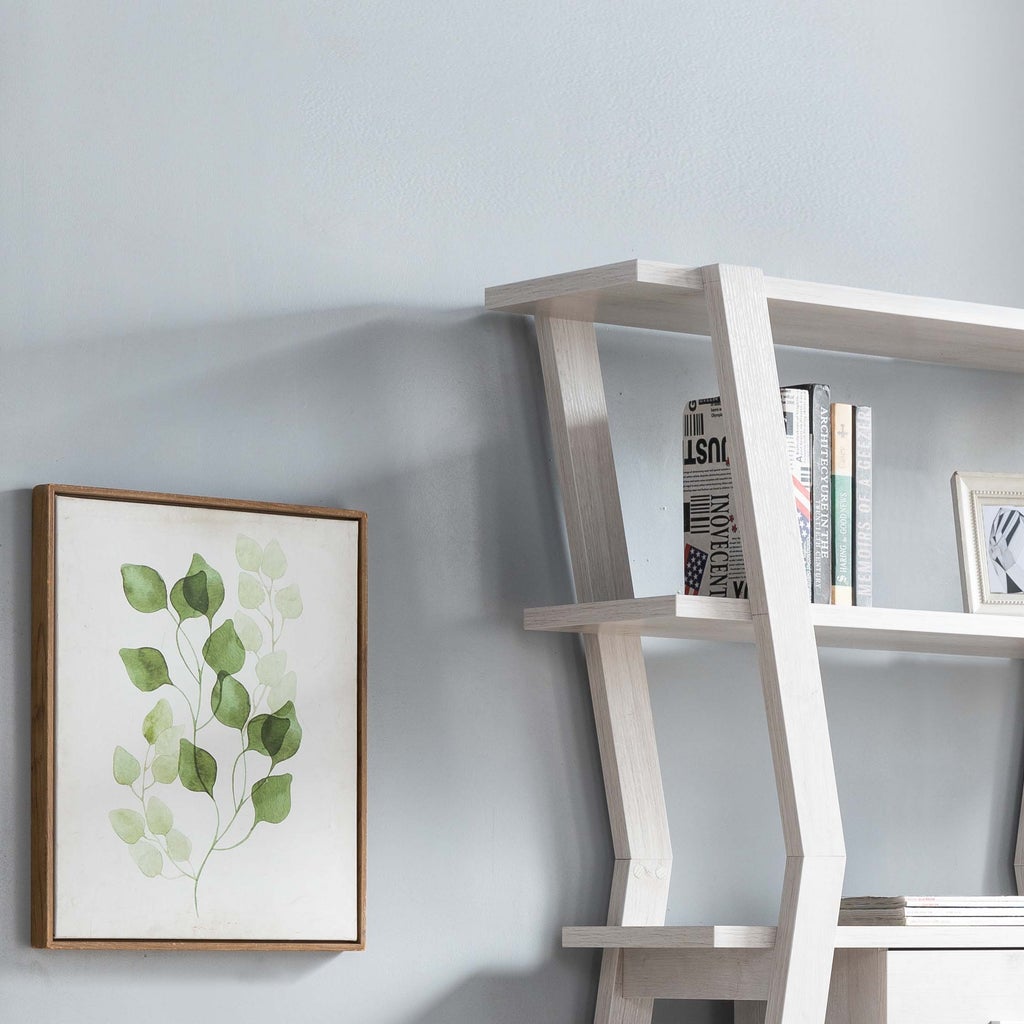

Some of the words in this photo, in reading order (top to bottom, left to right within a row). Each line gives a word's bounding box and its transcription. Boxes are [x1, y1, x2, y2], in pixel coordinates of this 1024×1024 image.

[839, 492, 848, 513] NEWS
[857, 495, 871, 514] OF
[821, 513, 829, 528] IN
[839, 514, 848, 535] GOOD
[821, 530, 829, 559] THE
[857, 521, 872, 597] MEMOIRS
